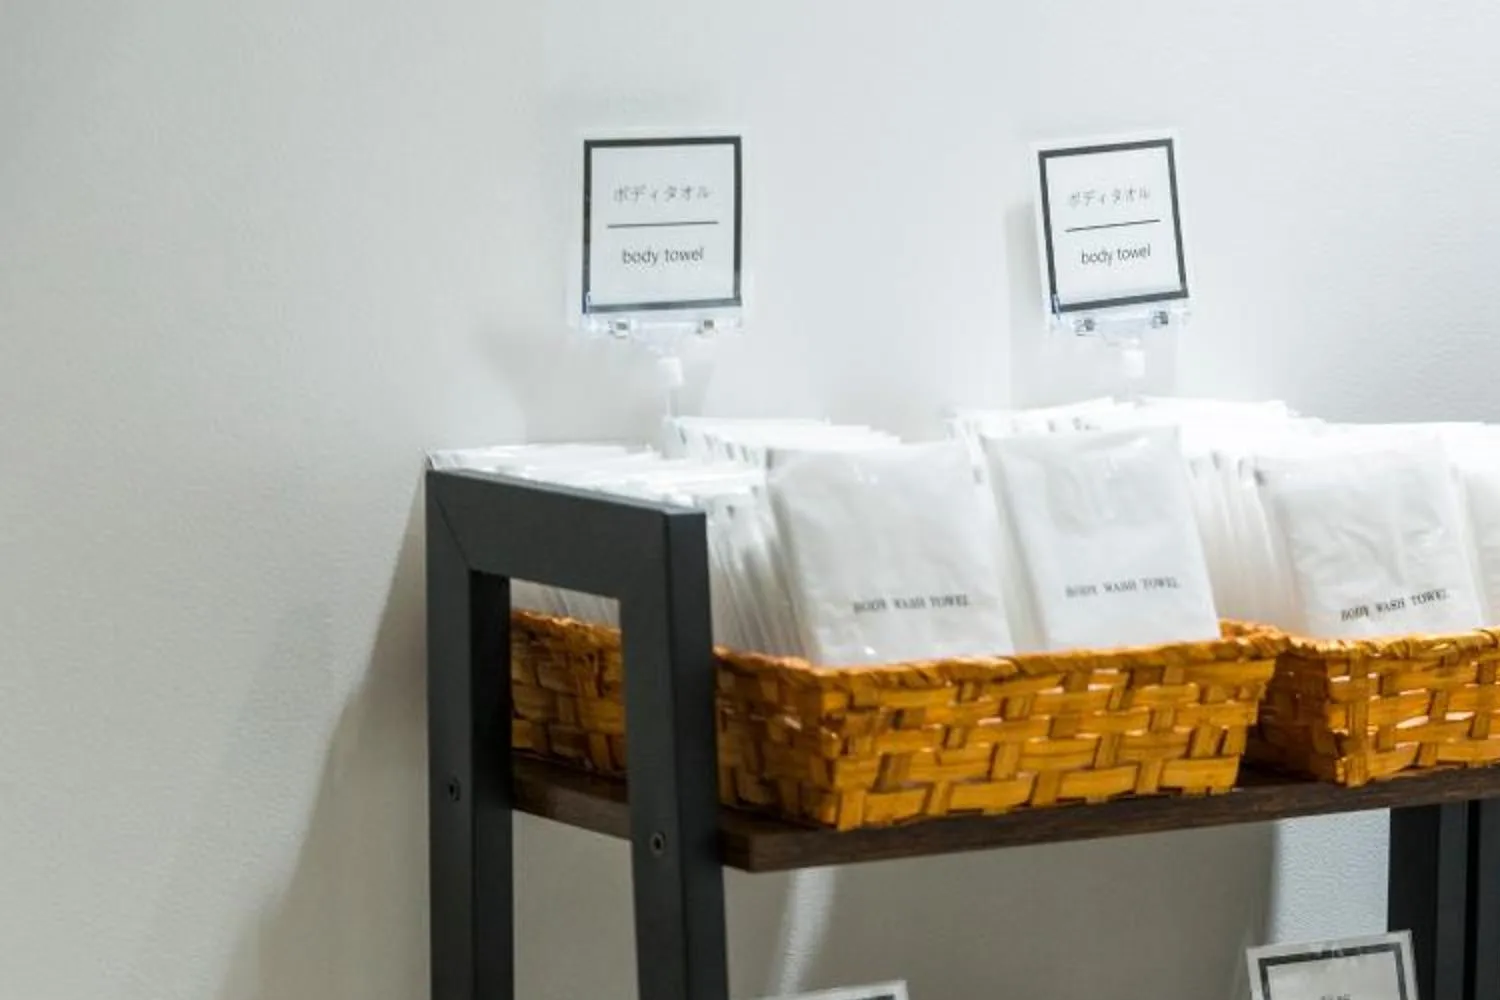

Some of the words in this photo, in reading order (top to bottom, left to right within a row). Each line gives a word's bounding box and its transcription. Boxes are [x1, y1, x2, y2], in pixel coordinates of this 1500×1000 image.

[621, 247, 659, 269] body
[664, 247, 705, 262] towel
[1081, 250, 1114, 267] body
[1117, 244, 1151, 262] towel
[1065, 583, 1098, 599] BODY
[1103, 580, 1137, 595] WASH
[1141, 576, 1180, 591] TOWEL
[853, 598, 888, 614] BODY
[894, 596, 926, 612] WASH
[930, 594, 969, 610] TOWEL
[1340, 603, 1370, 622] BODY
[1375, 597, 1406, 614] WASH
[1410, 588, 1449, 606] TOWEL
